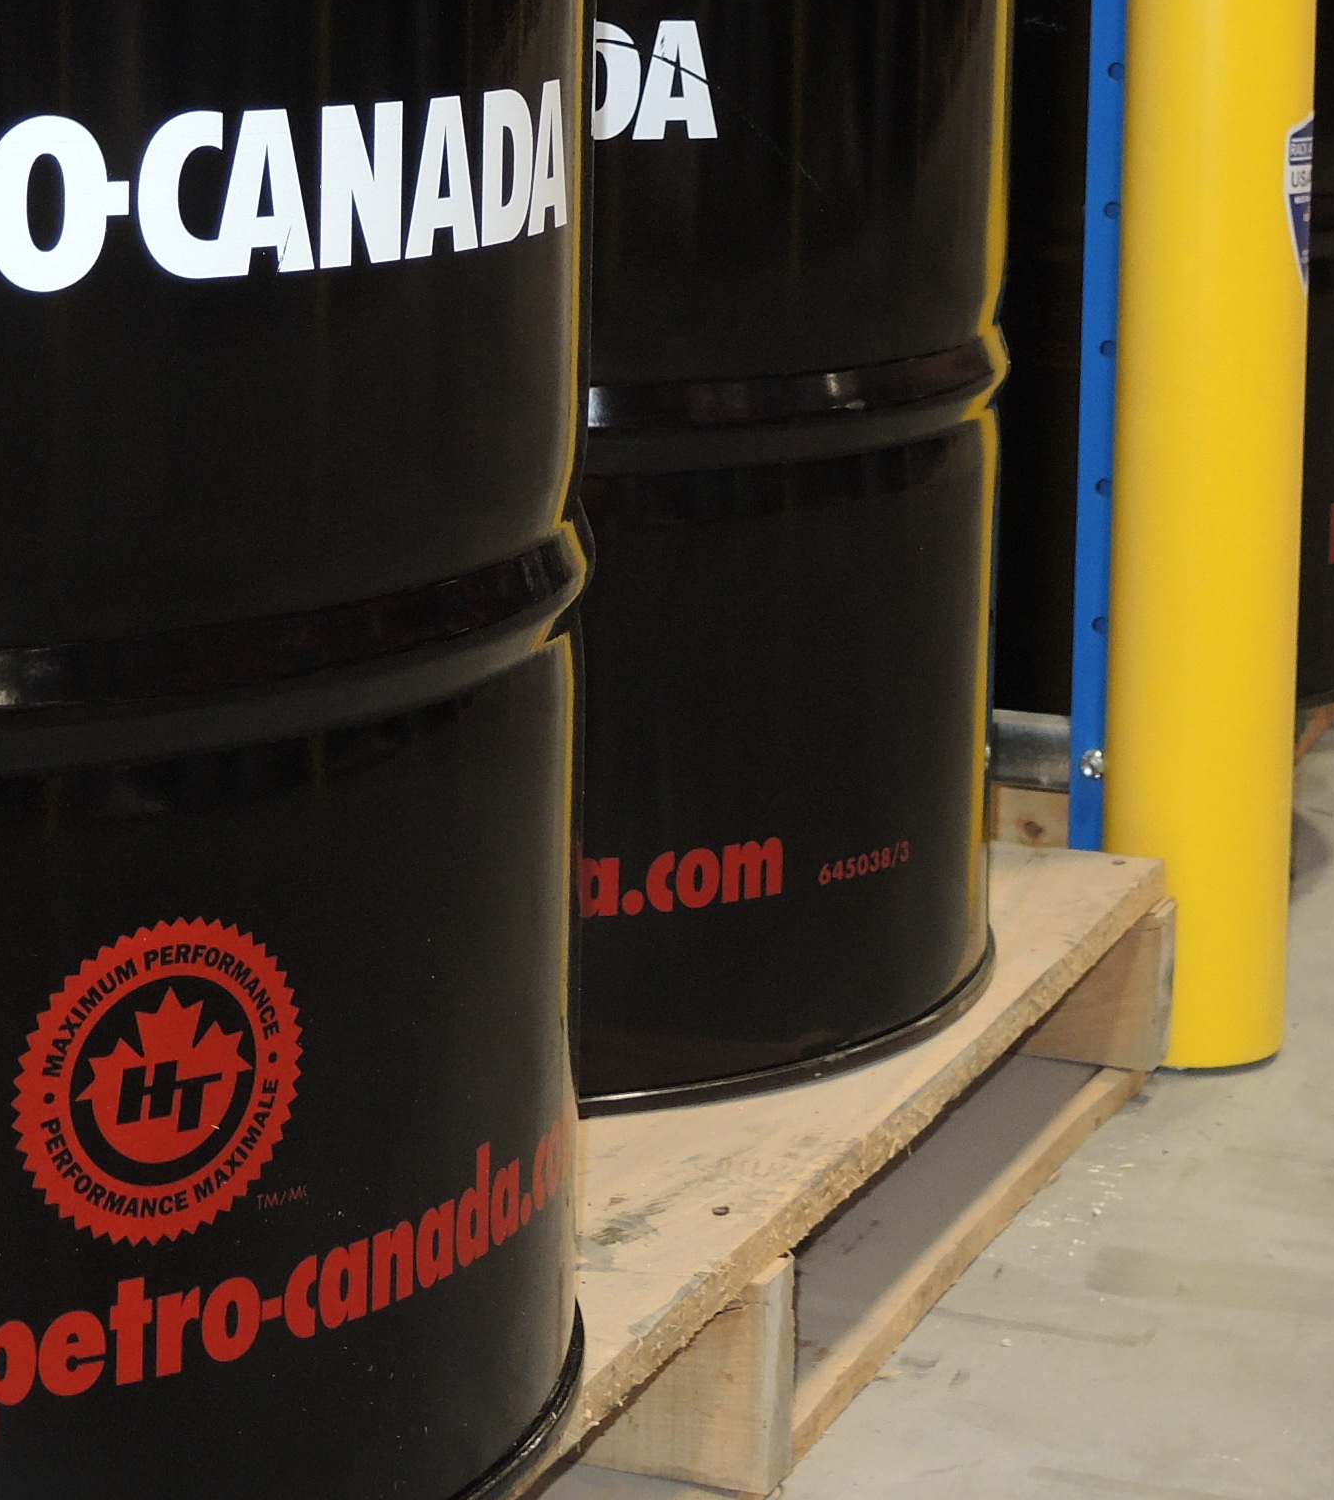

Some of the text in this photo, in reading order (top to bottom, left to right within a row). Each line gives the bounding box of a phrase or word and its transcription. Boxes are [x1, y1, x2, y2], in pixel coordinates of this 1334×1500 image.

[818, 840, 911, 886] 645038/3
[43, 942, 281, 1079] MAXIMUM PERFORMANCE
[40, 1078, 279, 1218] PERFORMANCE MAXIMALE
[116, 1059, 223, 1133] HT
